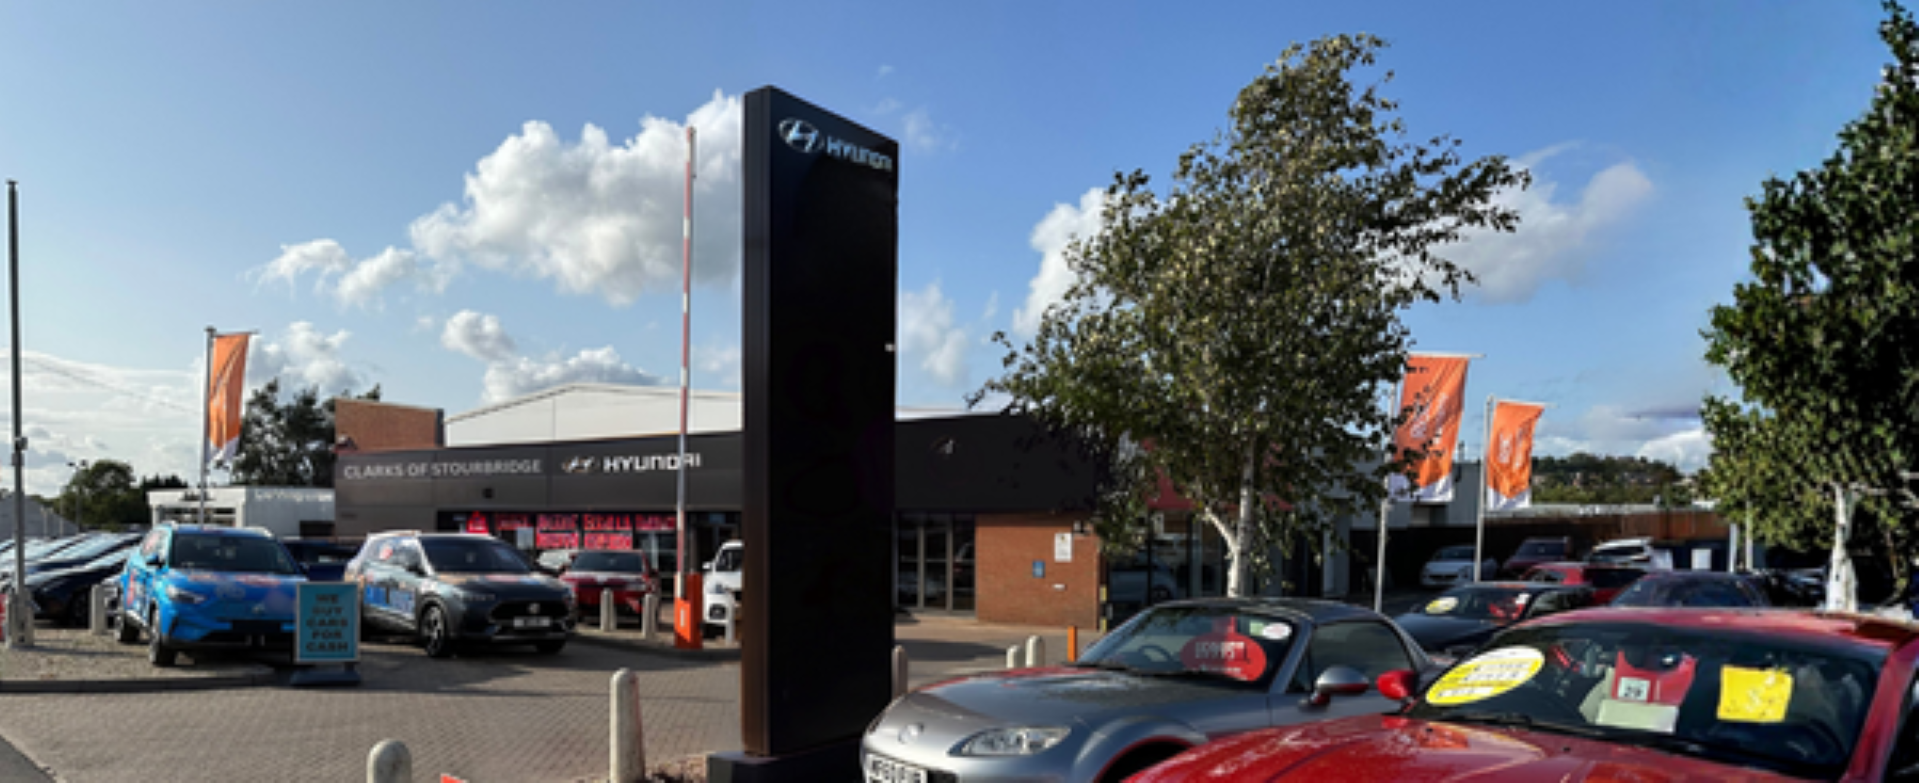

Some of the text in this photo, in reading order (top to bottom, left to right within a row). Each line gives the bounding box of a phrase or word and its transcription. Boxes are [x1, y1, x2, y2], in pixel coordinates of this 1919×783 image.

[827, 136, 893, 171] HYUNDAI
[343, 458, 543, 479] CLARKS OF STOURBRIDGE
[603, 452, 701, 473] HYUNDAI
[306, 617, 348, 628] CARS
[312, 629, 343, 639] FOR
[306, 641, 348, 652] CASH
